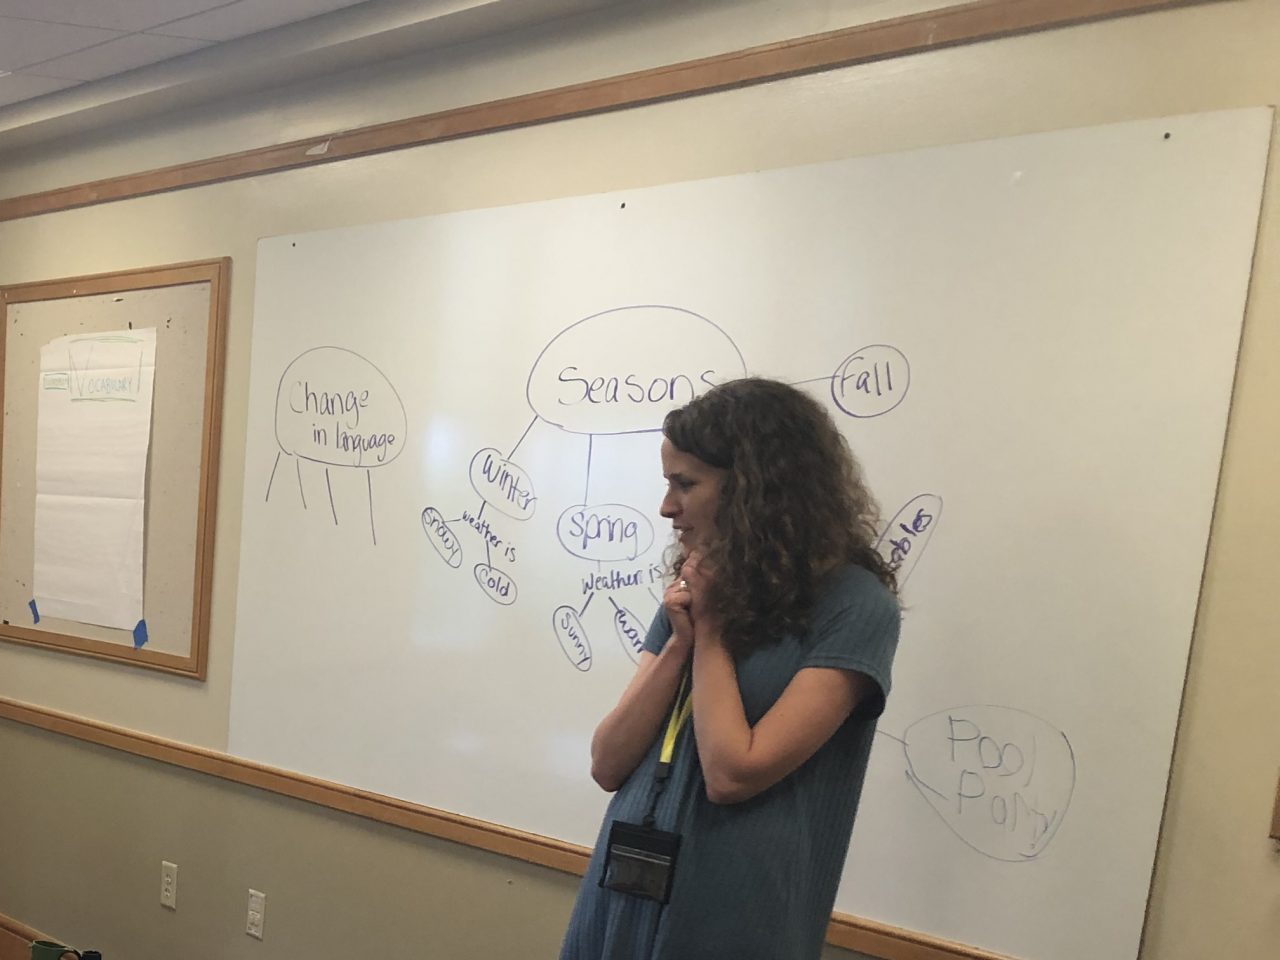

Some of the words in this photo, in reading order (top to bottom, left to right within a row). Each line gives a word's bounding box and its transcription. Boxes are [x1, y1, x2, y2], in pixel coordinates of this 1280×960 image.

[558, 366, 717, 406] Seasons
[312, 423, 327, 446] in
[336, 421, 396, 466] language
[504, 542, 516, 563] is
[886, 507, 933, 573] ables
